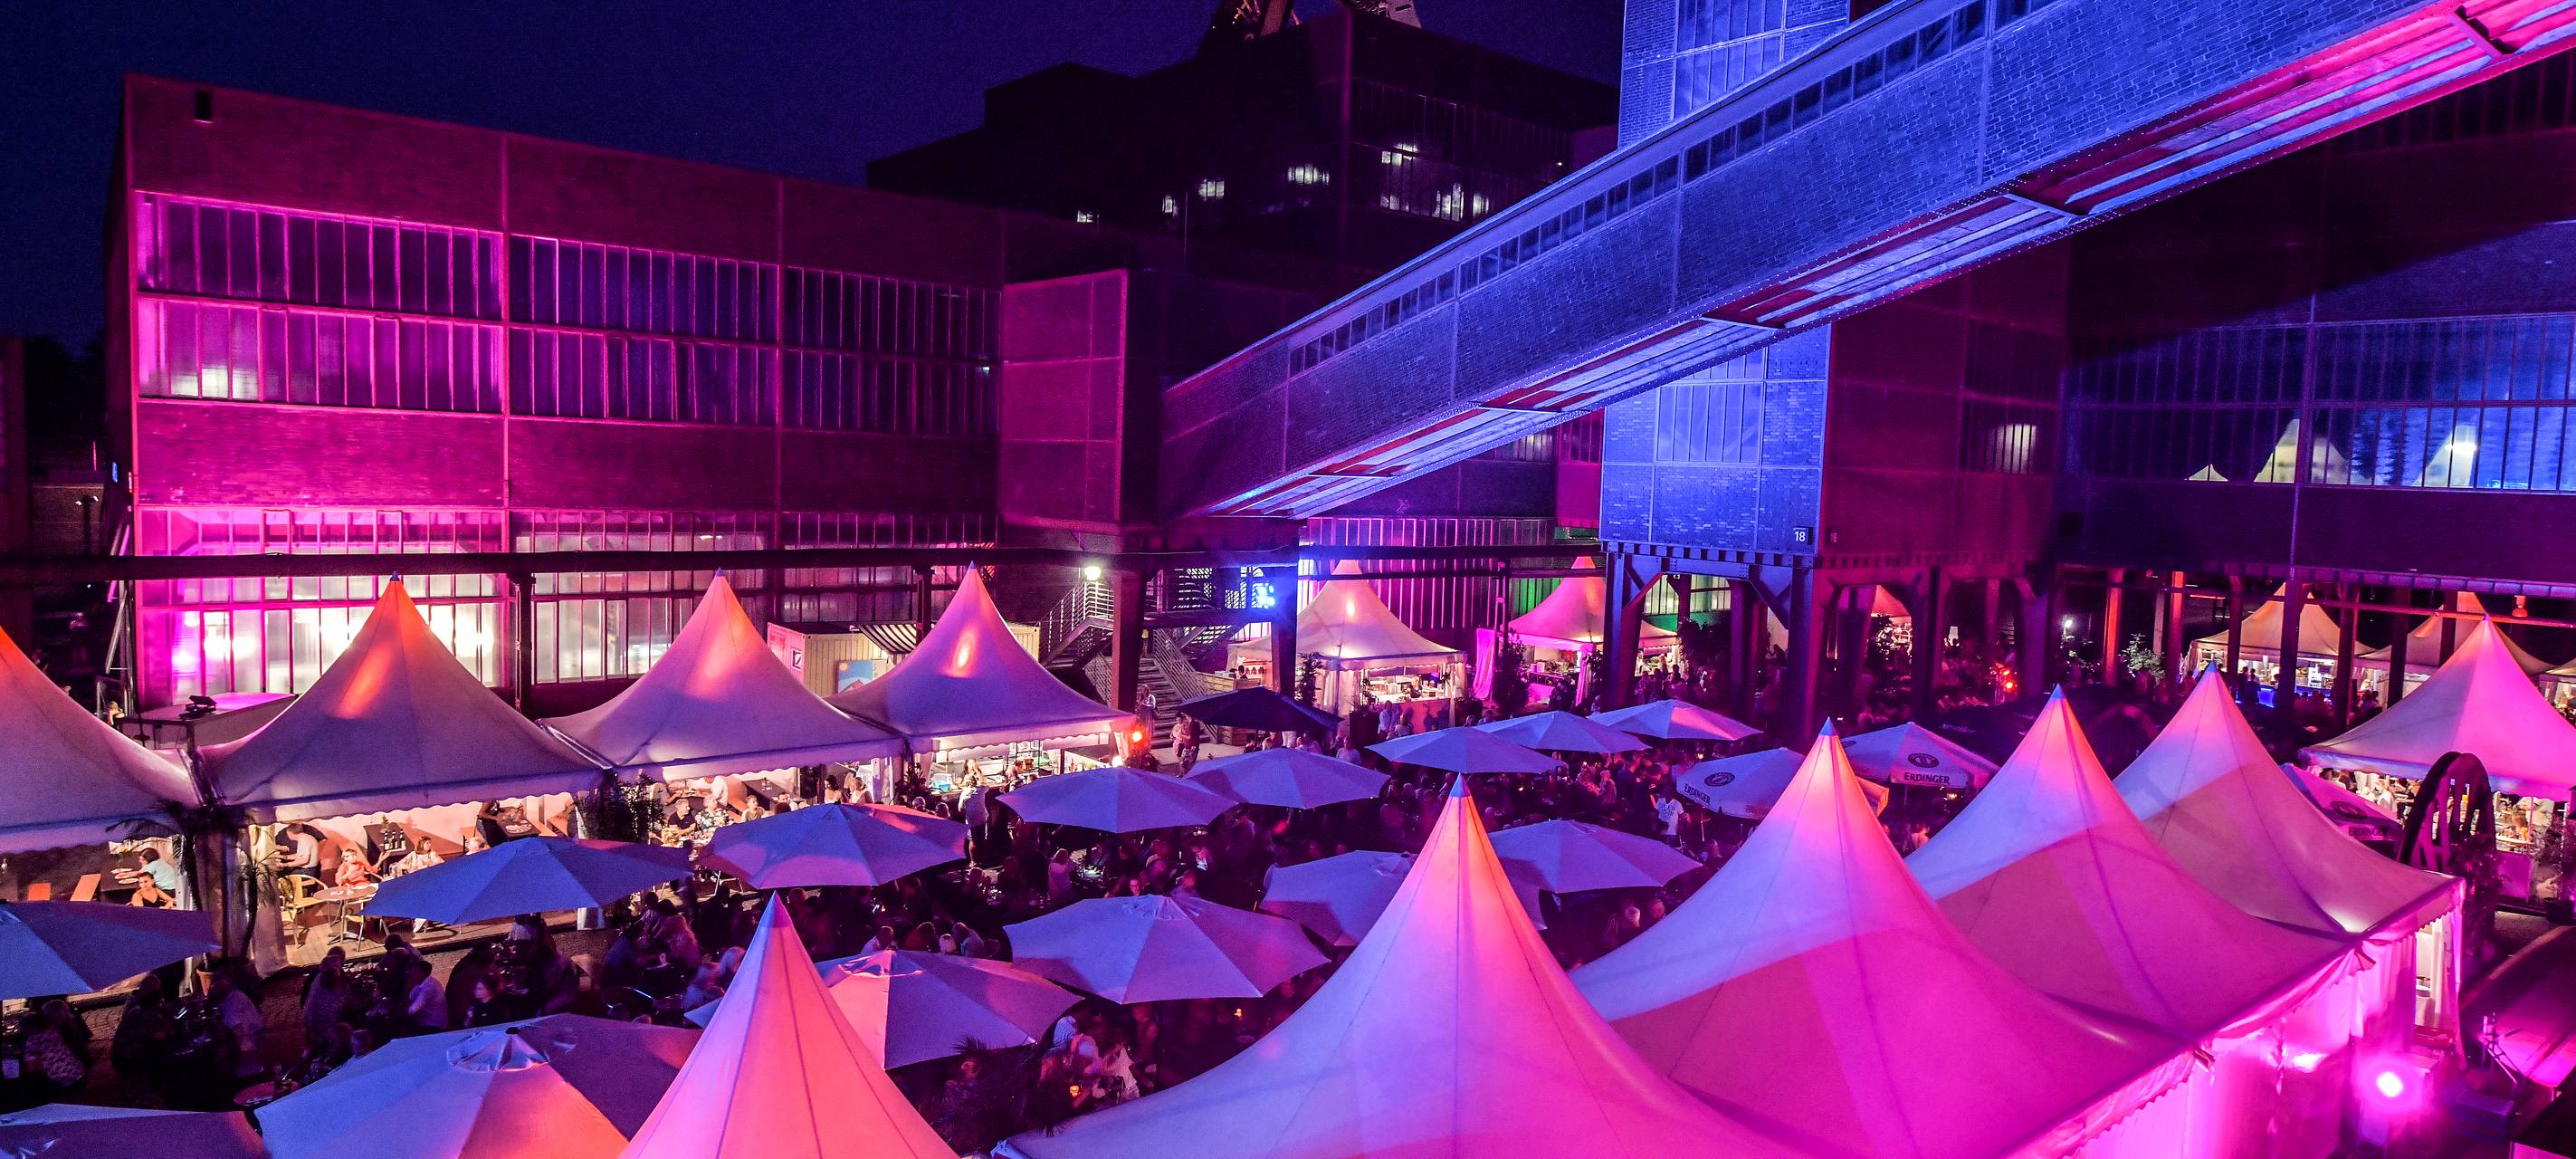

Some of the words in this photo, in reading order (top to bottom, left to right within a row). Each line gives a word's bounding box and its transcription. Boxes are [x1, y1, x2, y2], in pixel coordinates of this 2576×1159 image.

[1795, 531, 1806, 541] 18
[1904, 771, 1950, 784] ERDINGER
[1684, 783, 1711, 805] ERDINGER
